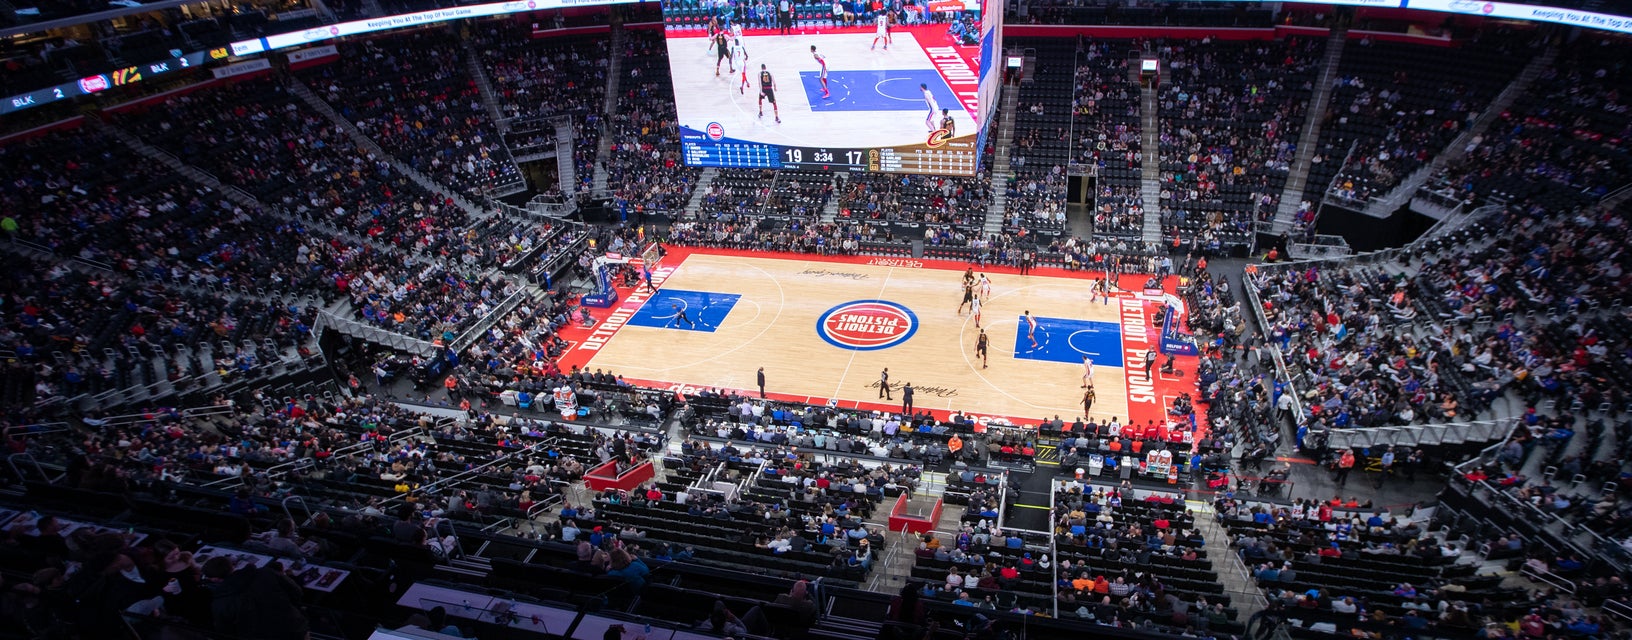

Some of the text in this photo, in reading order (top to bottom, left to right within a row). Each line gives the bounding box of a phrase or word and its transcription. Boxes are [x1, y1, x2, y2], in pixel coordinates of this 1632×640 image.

[367, 19, 392, 28] Keeping
[1532, 9, 1565, 20] Keeping
[1567, 13, 1579, 21] You
[1592, 16, 1606, 24] The
[1607, 18, 1622, 28] Top
[150, 62, 170, 74] BLK
[12, 88, 64, 108] BLK 2
[786, 148, 802, 163] 19
[814, 152, 833, 162] 3:34
[845, 150, 862, 165] 17
[838, 314, 898, 326] PISTONS
[578, 306, 635, 350] DETROIT
[834, 322, 895, 335] DETROIT
[1122, 300, 1156, 404] DETROIT PISTONS
